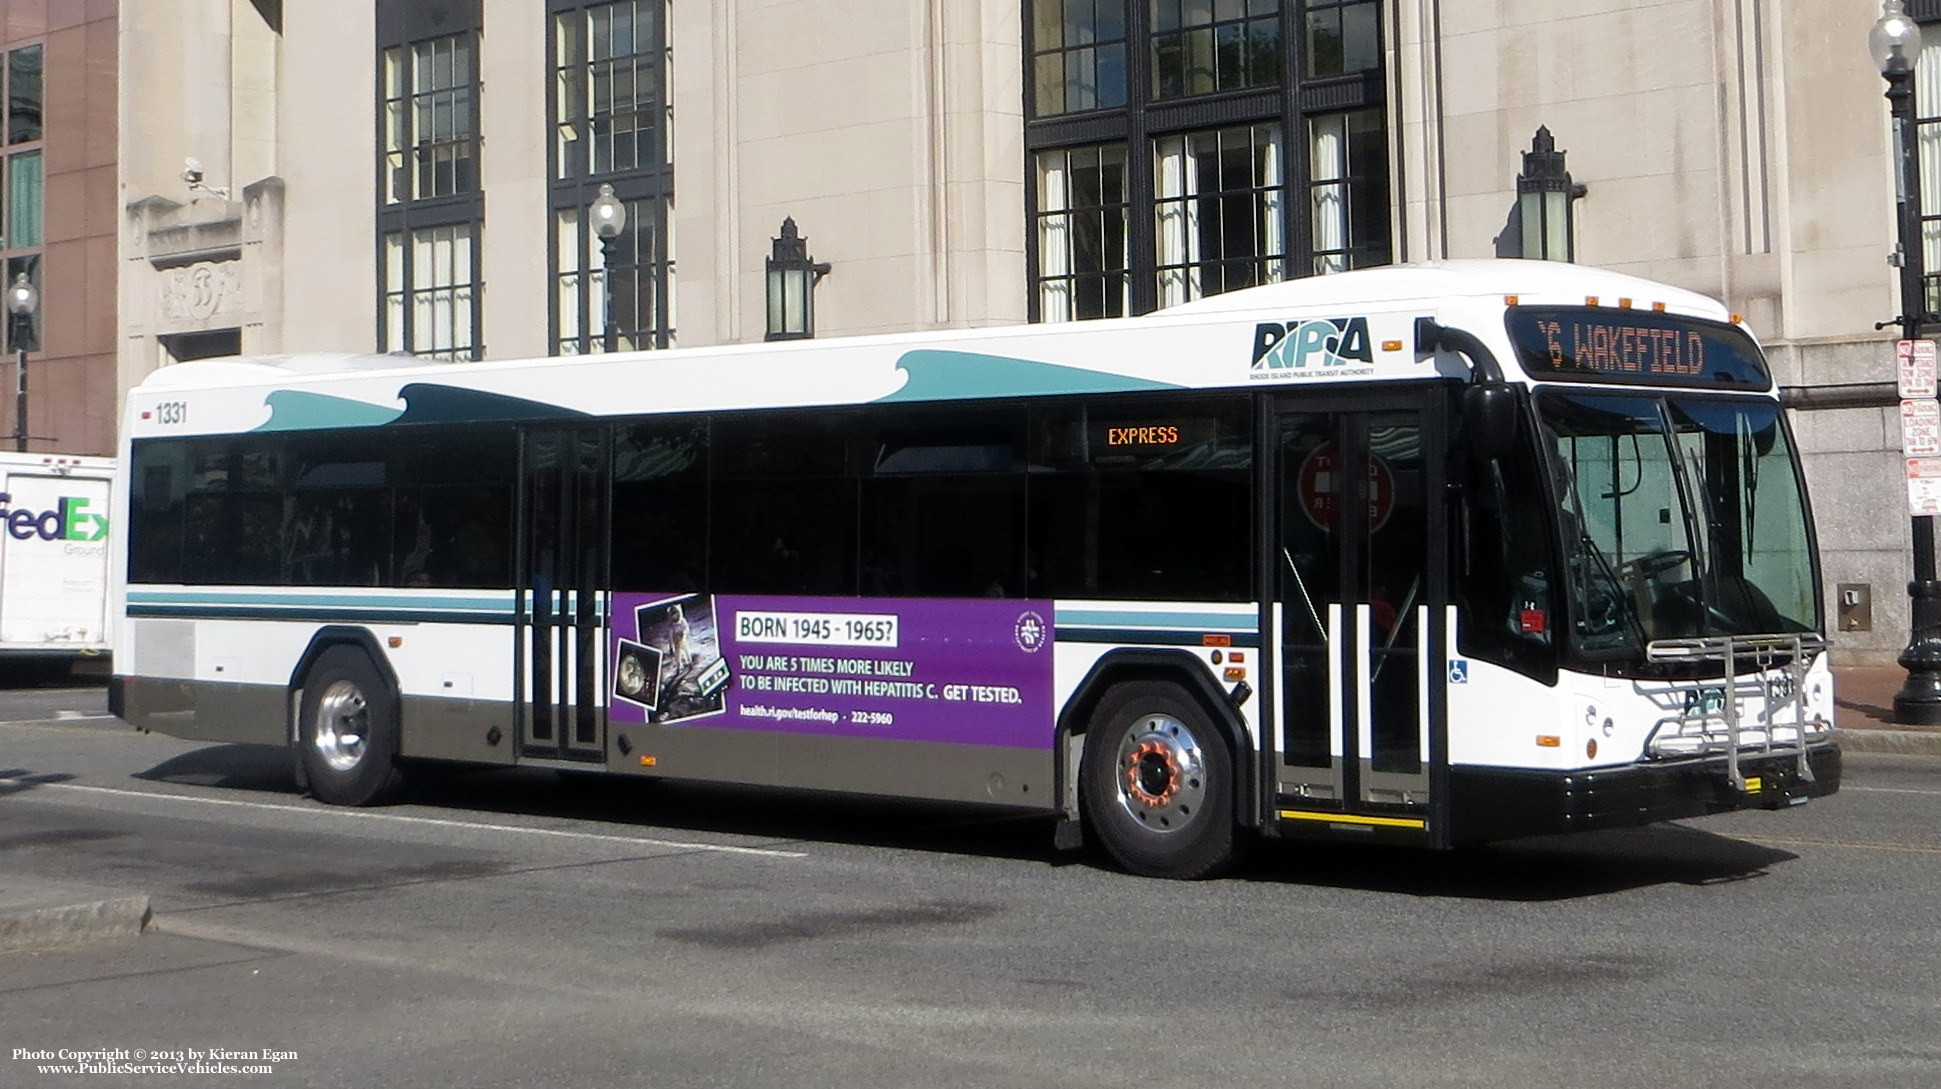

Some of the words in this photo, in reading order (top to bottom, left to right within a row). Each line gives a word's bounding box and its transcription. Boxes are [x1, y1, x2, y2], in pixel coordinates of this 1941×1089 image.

[1251, 317, 1374, 369] RIPTA
[1574, 323, 1703, 374] WAKEFIELD
[1249, 372, 1269, 380] RHODE
[1270, 372, 1292, 380] ISLAND
[1293, 371, 1313, 379] PUBLIC
[1314, 369, 1339, 377] TRANSIT
[1340, 367, 1374, 376] AUTHORITY
[156, 401, 187, 424] 1331
[1904, 417, 1938, 427] LOADING
[1108, 426, 1178, 445] EXPRESS
[1912, 427, 1931, 436] ZONE
[64, 543, 105, 556] Ground
[740, 616, 787, 638] BORN
[793, 619, 831, 639] 1945
[845, 620, 893, 641] 1965?
[740, 655, 764, 670] YOU
[766, 656, 788, 671] ARE
[790, 657, 798, 671] 5
[800, 657, 835, 673] TIMES
[837, 659, 872, 675] MORE
[874, 661, 914, 677] LIKELY
[740, 675, 756, 689] TO
[757, 676, 773, 690] BE
[774, 677, 829, 693] INFECTED
[831, 678, 862, 695] WITH
[864, 680, 924, 698] HEPATITIS
[926, 684, 939, 699] C.
[943, 685, 969, 701] GET
[970, 686, 1022, 704] TESTED.
[740, 704, 839, 724] health.ri.gov/testforhep
[850, 711, 893, 725] 222-5960
